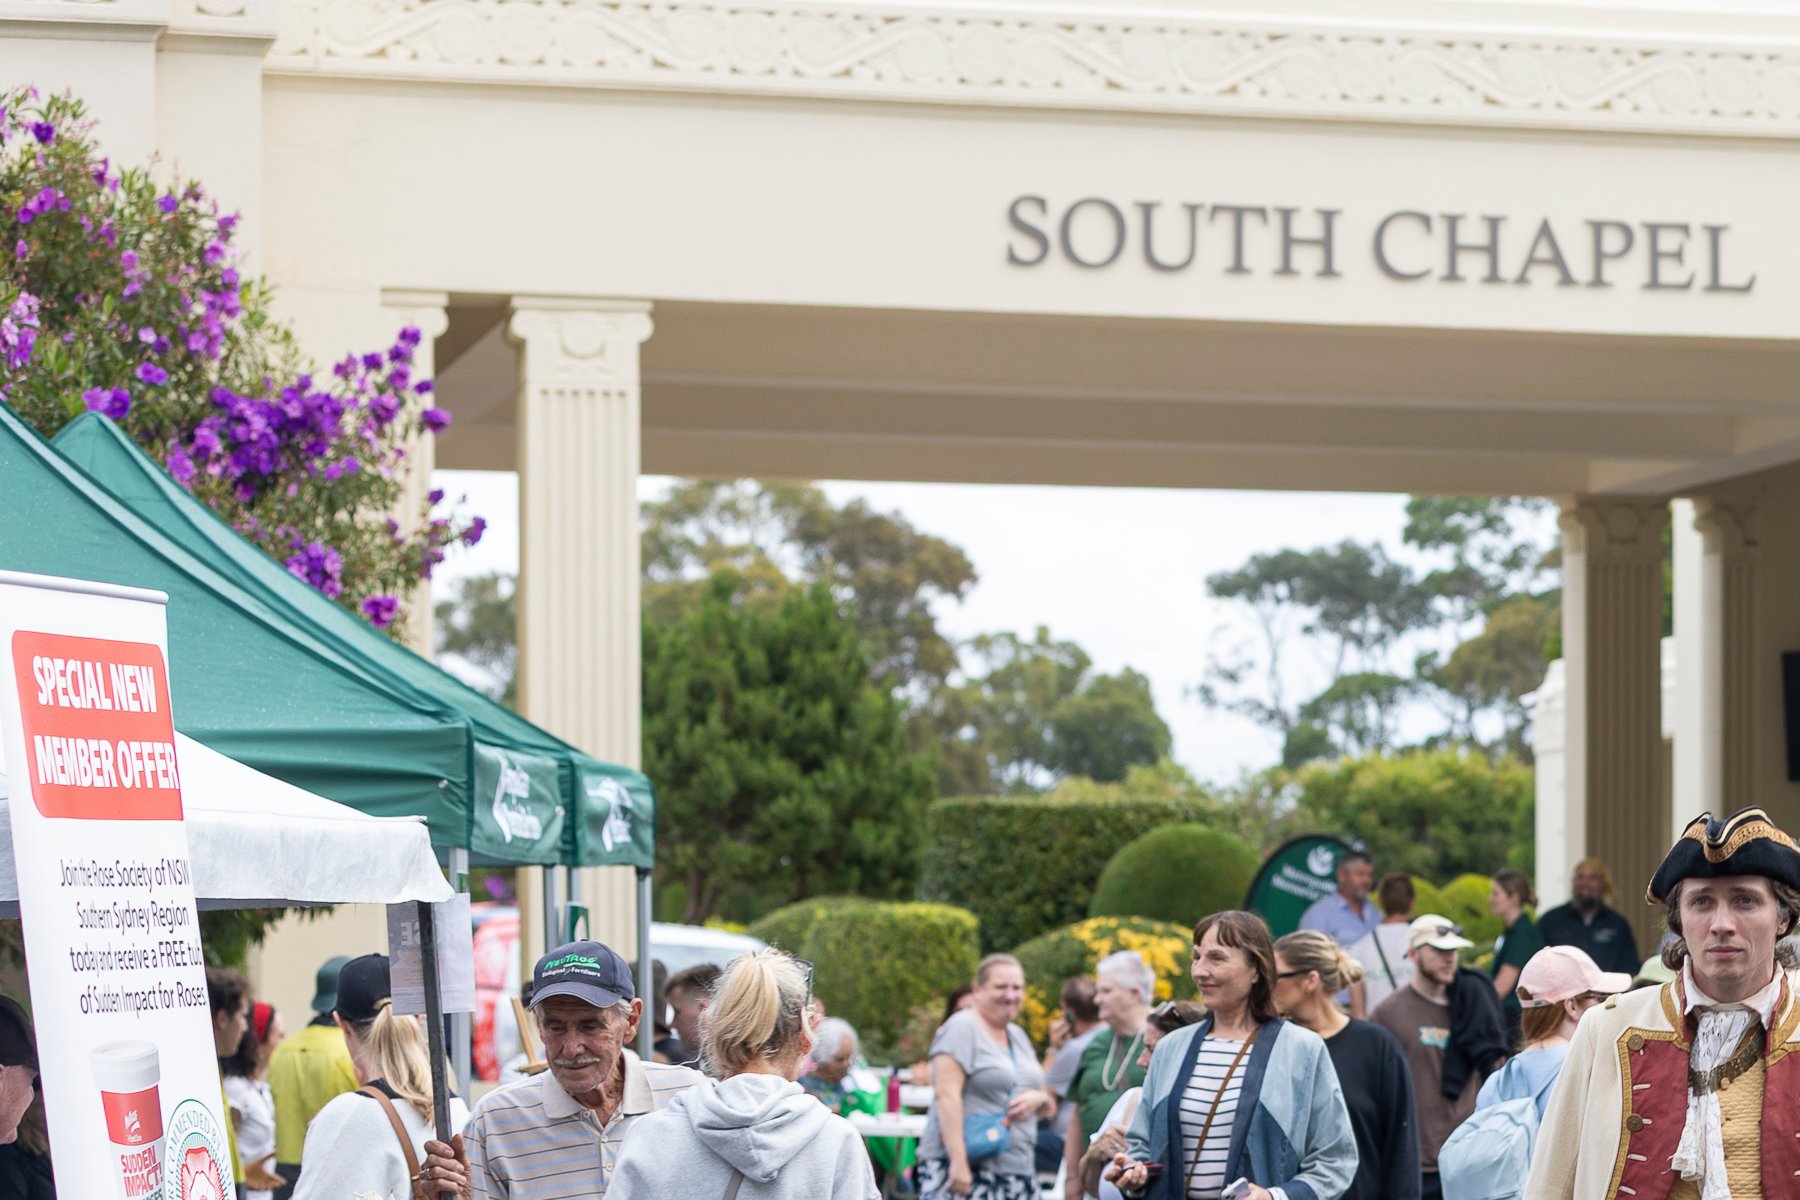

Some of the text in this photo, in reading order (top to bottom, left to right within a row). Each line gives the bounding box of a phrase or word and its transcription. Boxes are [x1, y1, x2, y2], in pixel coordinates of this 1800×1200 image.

[1005, 194, 1757, 295] SOUTH CHAPEL
[32, 655, 158, 713] SPECIAL NEW
[33, 734, 180, 790] MEMBER OFFER
[91, 860, 115, 887] Rose
[115, 859, 153, 893] Society
[154, 858, 167, 886] of
[166, 859, 190, 886] NSW
[113, 900, 150, 936] Sydney
[150, 900, 190, 934] Region
[114, 943, 149, 970] receive
[151, 948, 158, 969] a
[158, 940, 188, 968] FREE
[80, 984, 94, 1014] of
[121, 985, 159, 1018] Impact
[158, 981, 175, 1009] for
[120, 1145, 157, 1174] SUDDEN
[123, 1161, 164, 1198] IMPACT!
